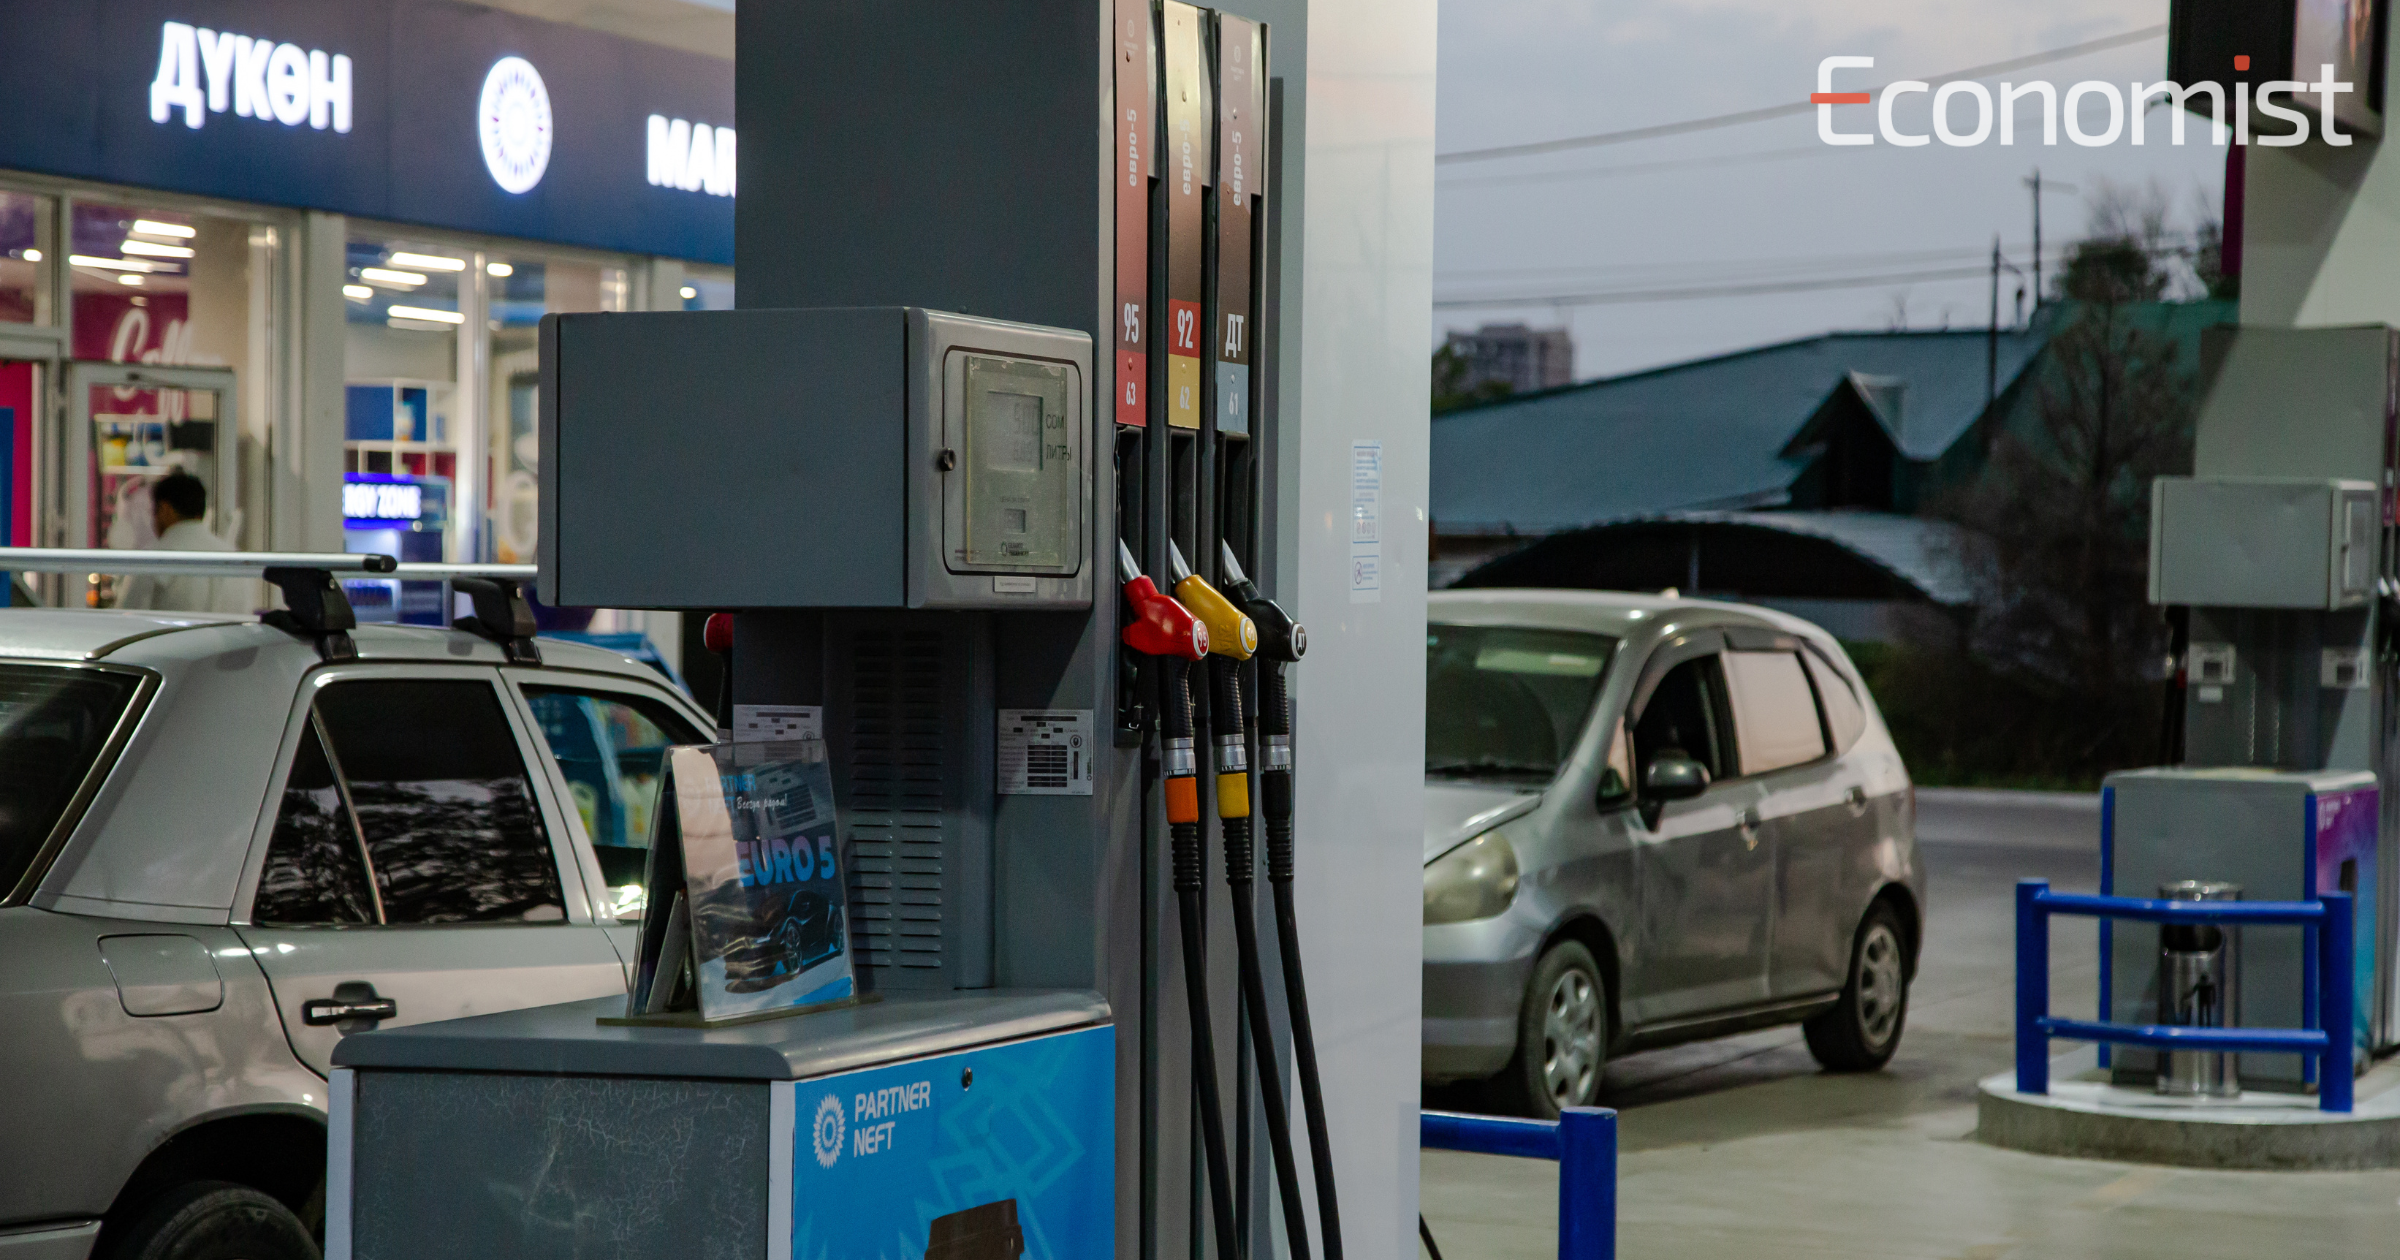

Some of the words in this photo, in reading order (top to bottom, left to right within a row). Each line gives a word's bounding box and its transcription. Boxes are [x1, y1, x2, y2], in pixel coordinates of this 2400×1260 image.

[150, 21, 353, 134] ДҮКӨН
[1126, 108, 1139, 187] евро-5
[1179, 119, 1193, 196] евро-5
[1231, 130, 1244, 206] евро-5
[1124, 302, 1139, 343] 95
[1177, 308, 1194, 348] 92
[1225, 313, 1244, 358] ДТ
[1126, 381, 1136, 406] 63
[1179, 385, 1190, 410] 62
[1229, 391, 1239, 416] 61
[1198, 630, 1207, 648] 95
[1297, 632, 1305, 650] ДТ
[735, 835, 815, 888] EURO
[818, 835, 836, 880] 5
[855, 1081, 930, 1123] PARTNER
[854, 1121, 896, 1158] NEFT
